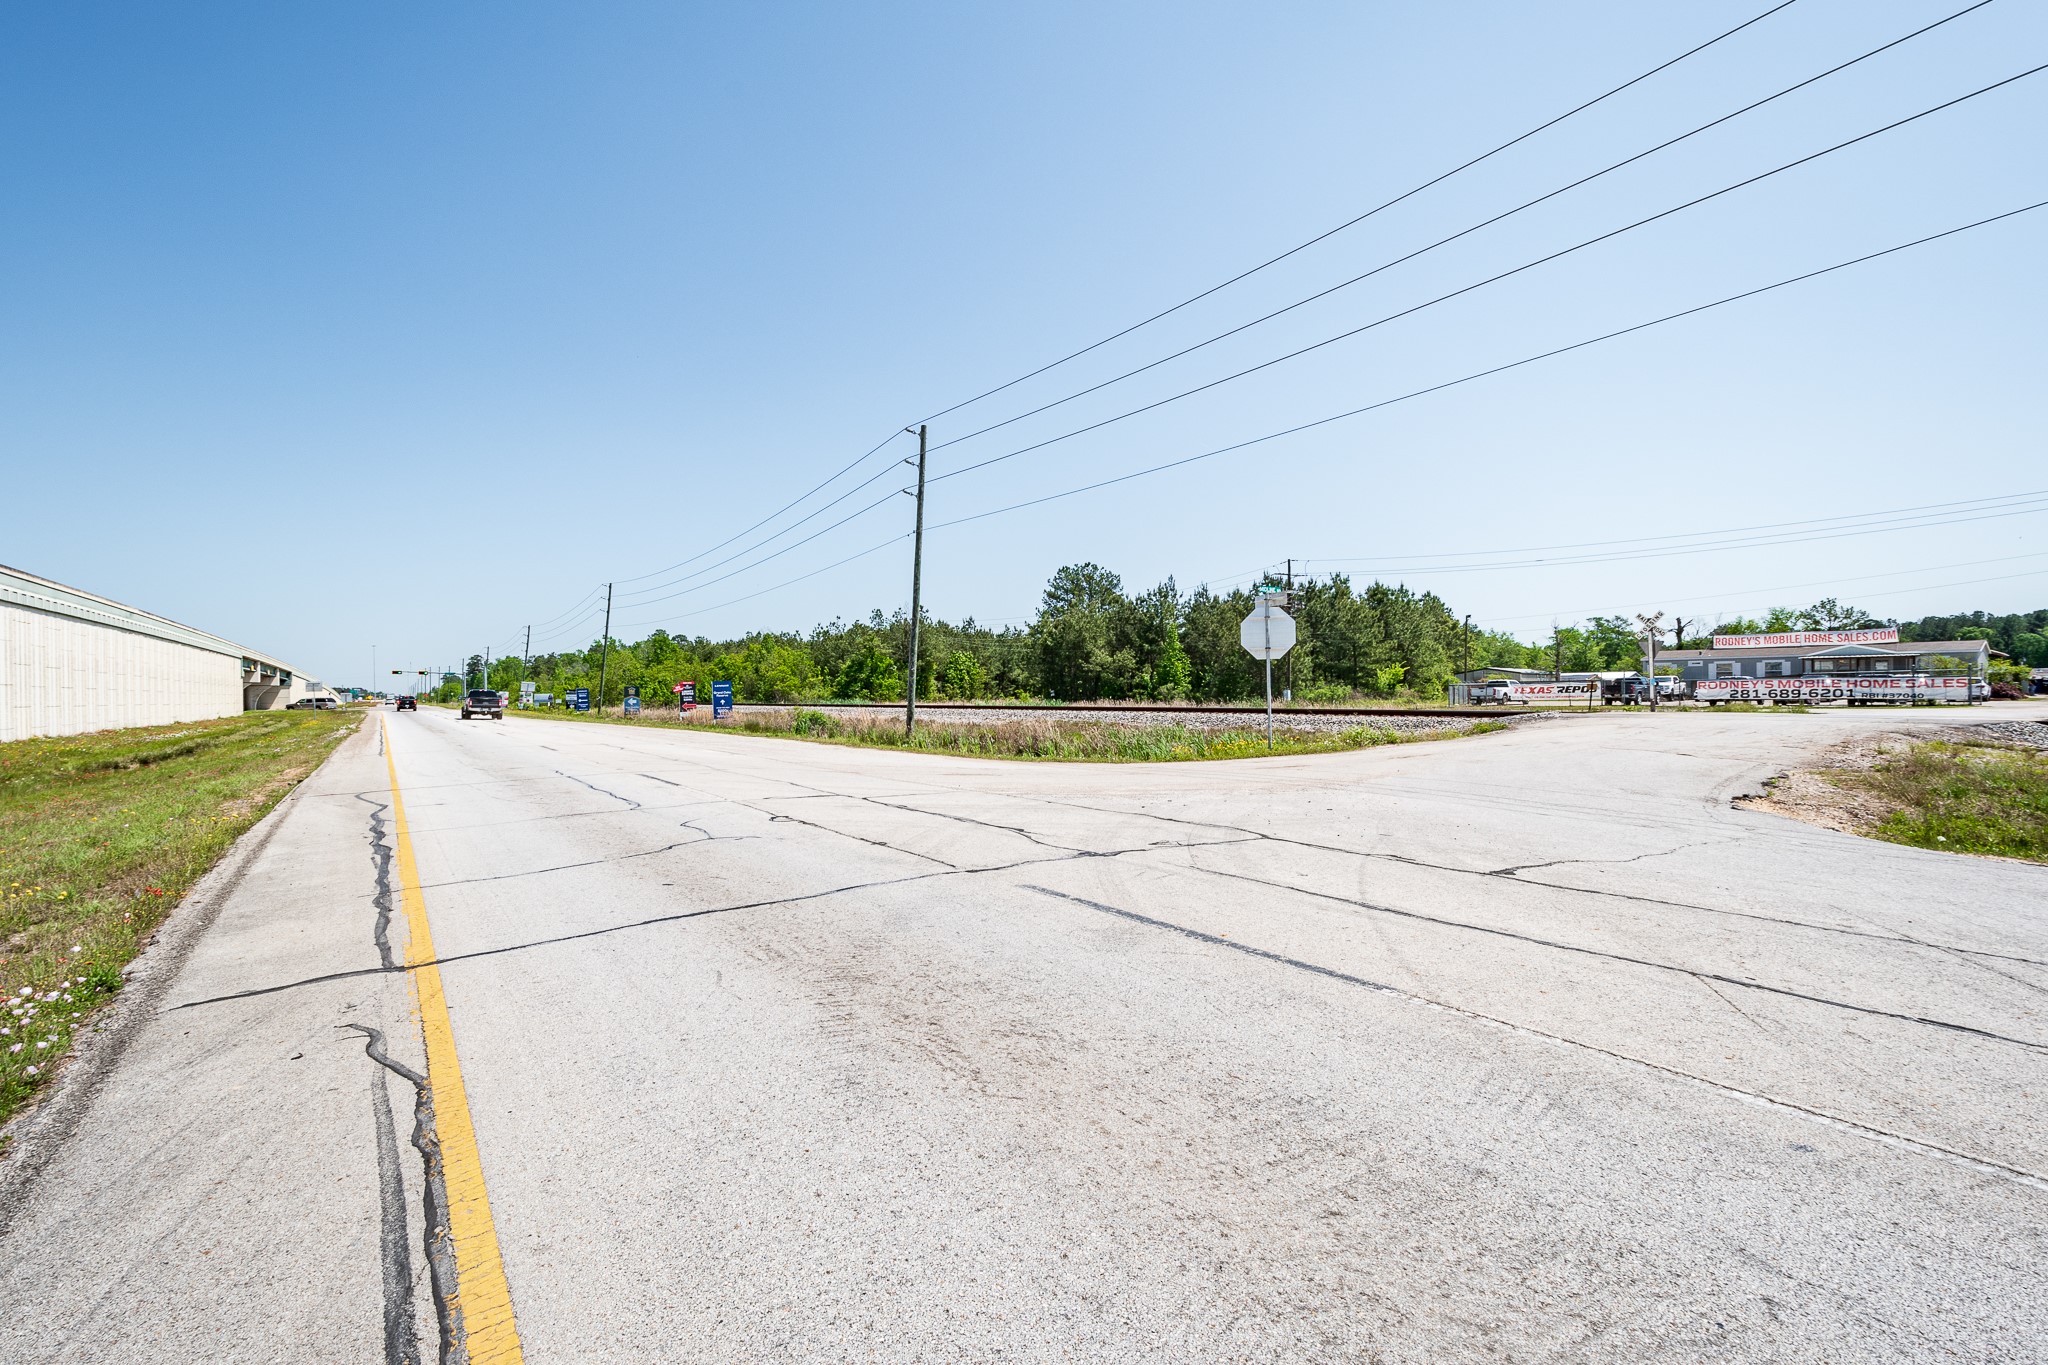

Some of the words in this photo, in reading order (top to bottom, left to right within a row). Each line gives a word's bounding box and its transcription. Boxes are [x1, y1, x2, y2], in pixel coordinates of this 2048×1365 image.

[1636, 611, 1664, 639] CROSSING
[1715, 636, 1760, 646] RODNEY'S
[1763, 634, 1801, 645] MOBILE
[1804, 633, 1834, 643] HOME
[1837, 630, 1897, 643] SALES.COM
[1697, 680, 1774, 689] RODNEY'S
[1777, 680, 1842, 689] MOBILE
[1846, 680, 1902, 689] HOME
[1905, 679, 1968, 689] SALES
[1514, 686, 1555, 694] TEXAS
[1729, 689, 1856, 698] 281-689-6201
